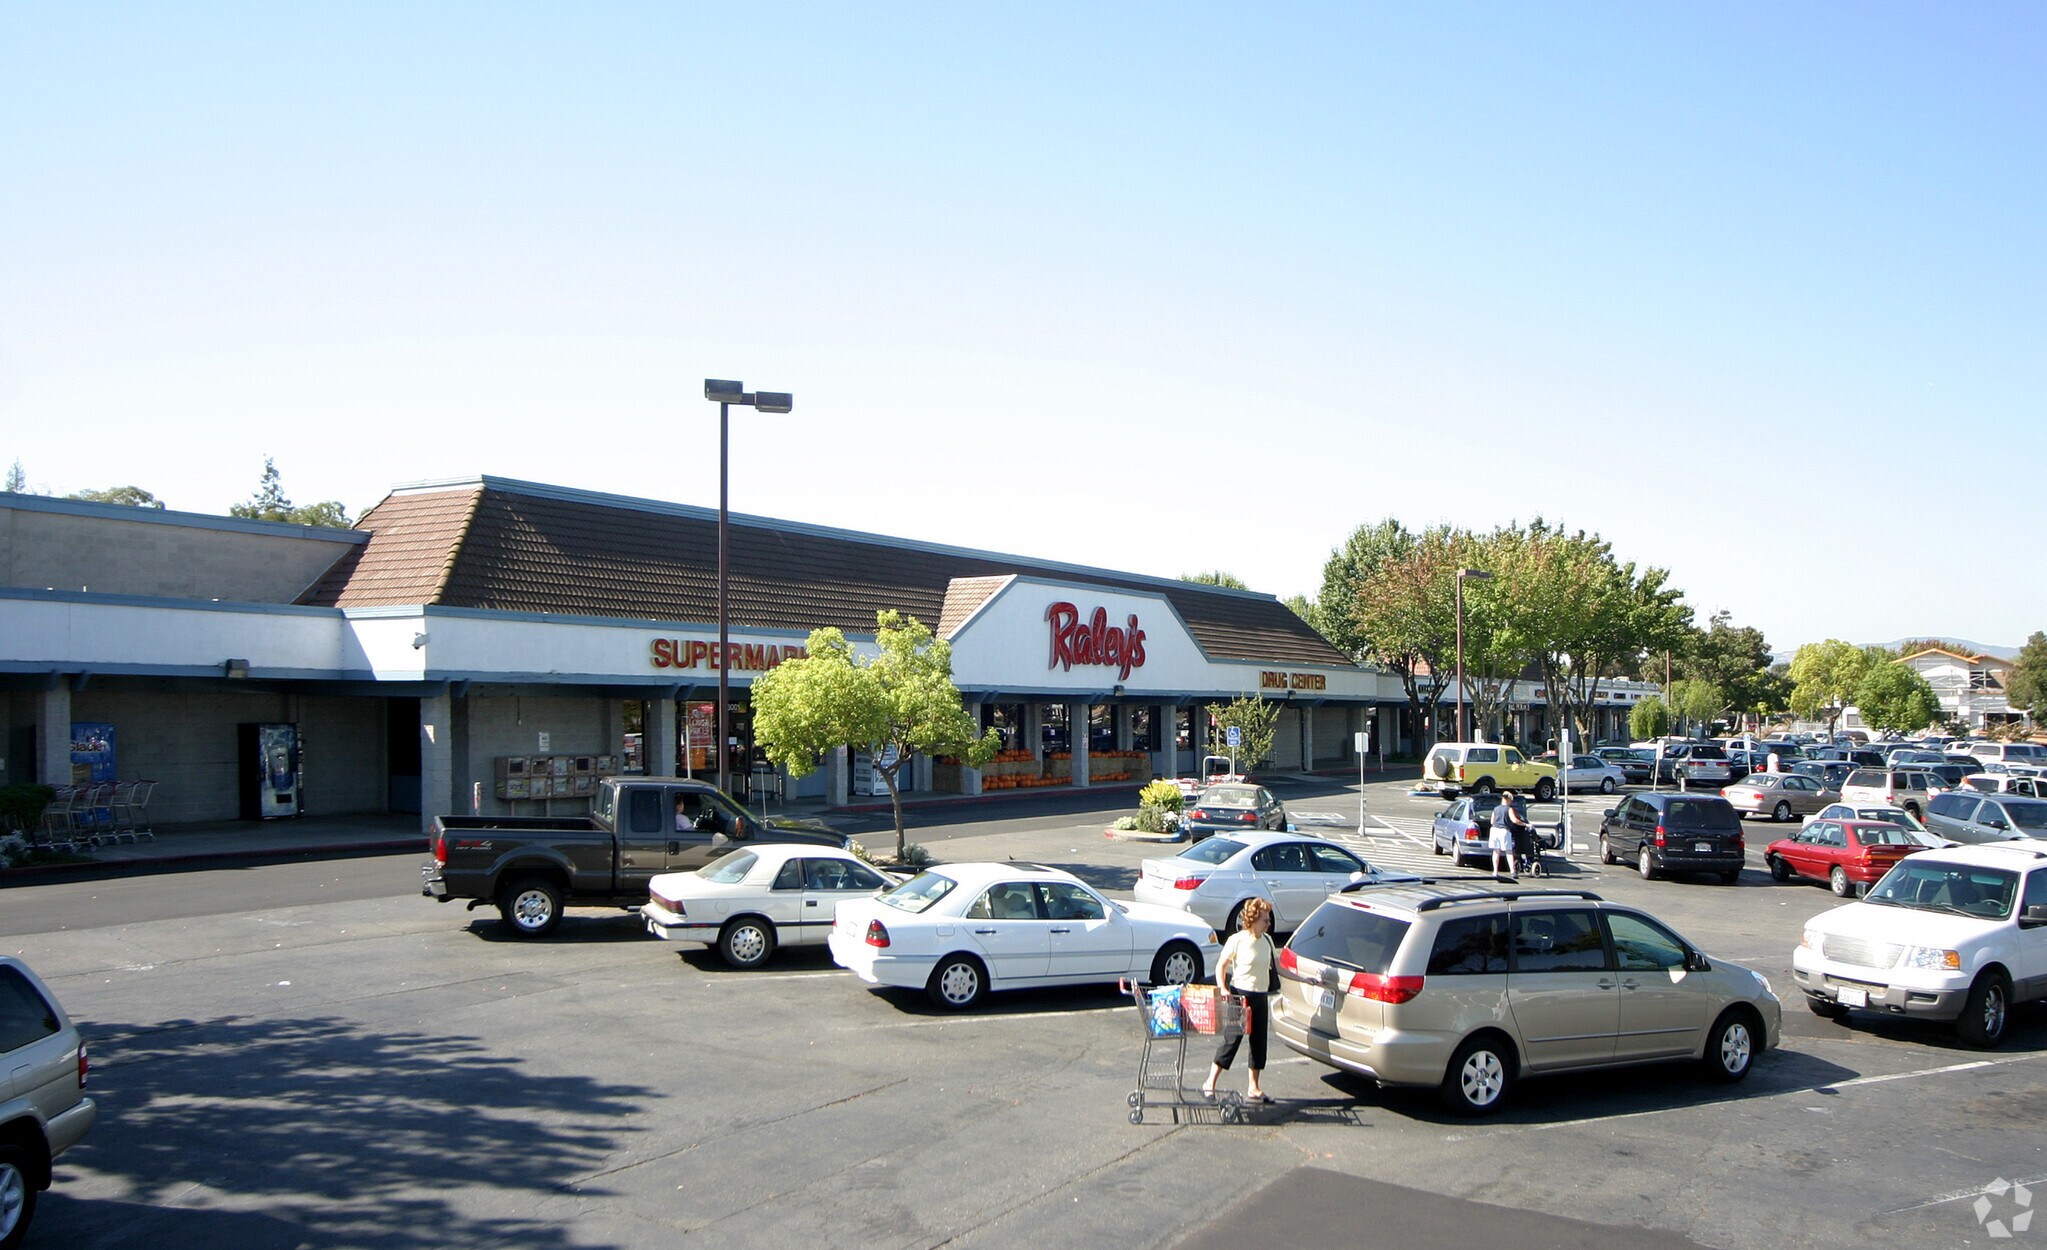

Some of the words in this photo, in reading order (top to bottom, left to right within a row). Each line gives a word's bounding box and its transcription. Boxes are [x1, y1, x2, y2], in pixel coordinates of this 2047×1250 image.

[652, 639, 810, 671] SUPERMAR
[1044, 602, 1147, 681] Raley's
[1260, 671, 1288, 689] DRUG
[1289, 673, 1327, 690] CENTER
